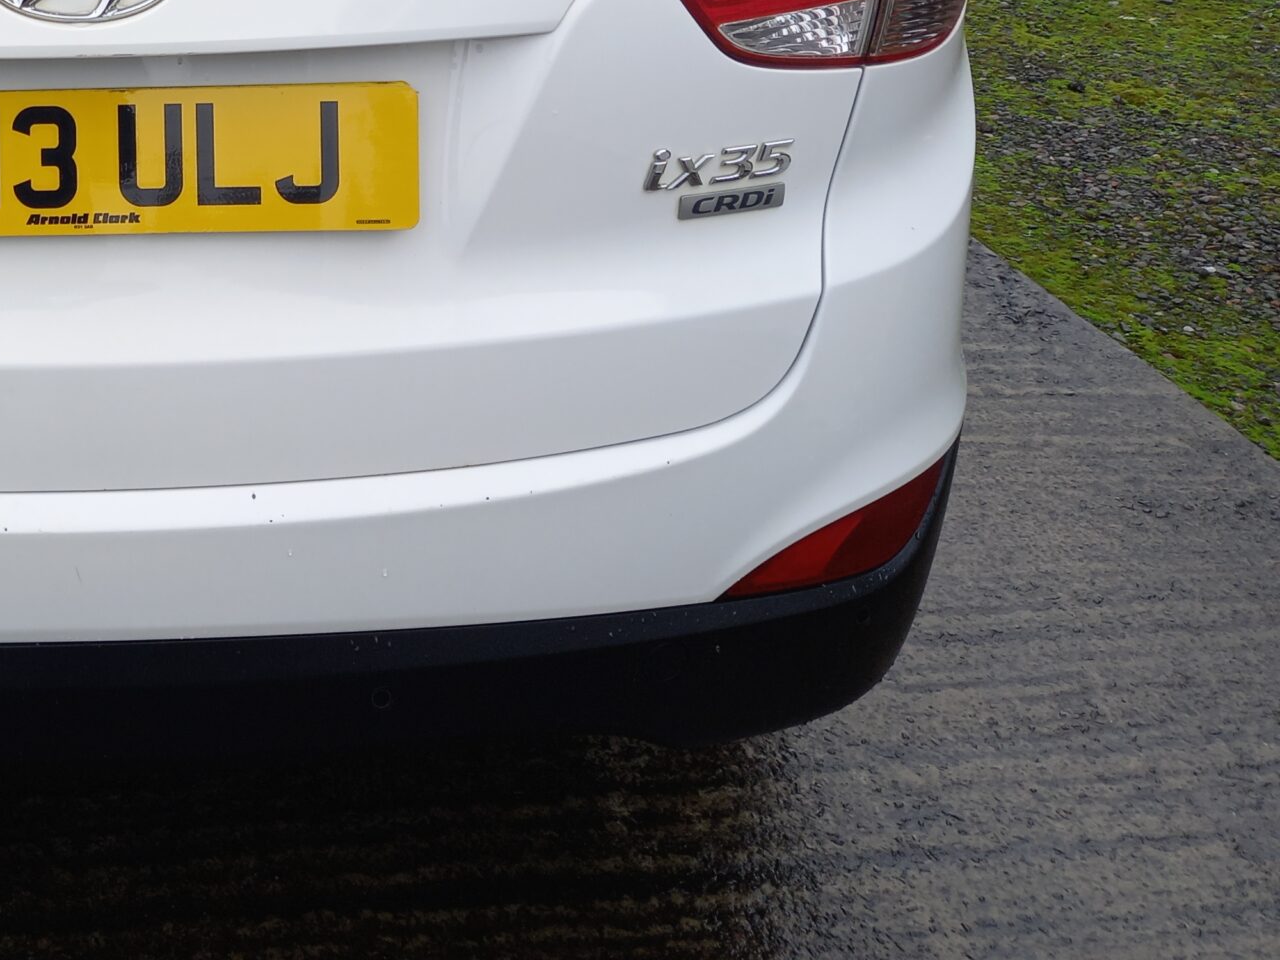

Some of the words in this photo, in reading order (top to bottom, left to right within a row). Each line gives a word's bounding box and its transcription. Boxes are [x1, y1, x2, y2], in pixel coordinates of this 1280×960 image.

[117, 100, 340, 208] ULJ
[643, 138, 795, 192] ix35
[26, 213, 89, 225] Arnold
[93, 212, 141, 224] Clark
[691, 189, 776, 215] CRDi
